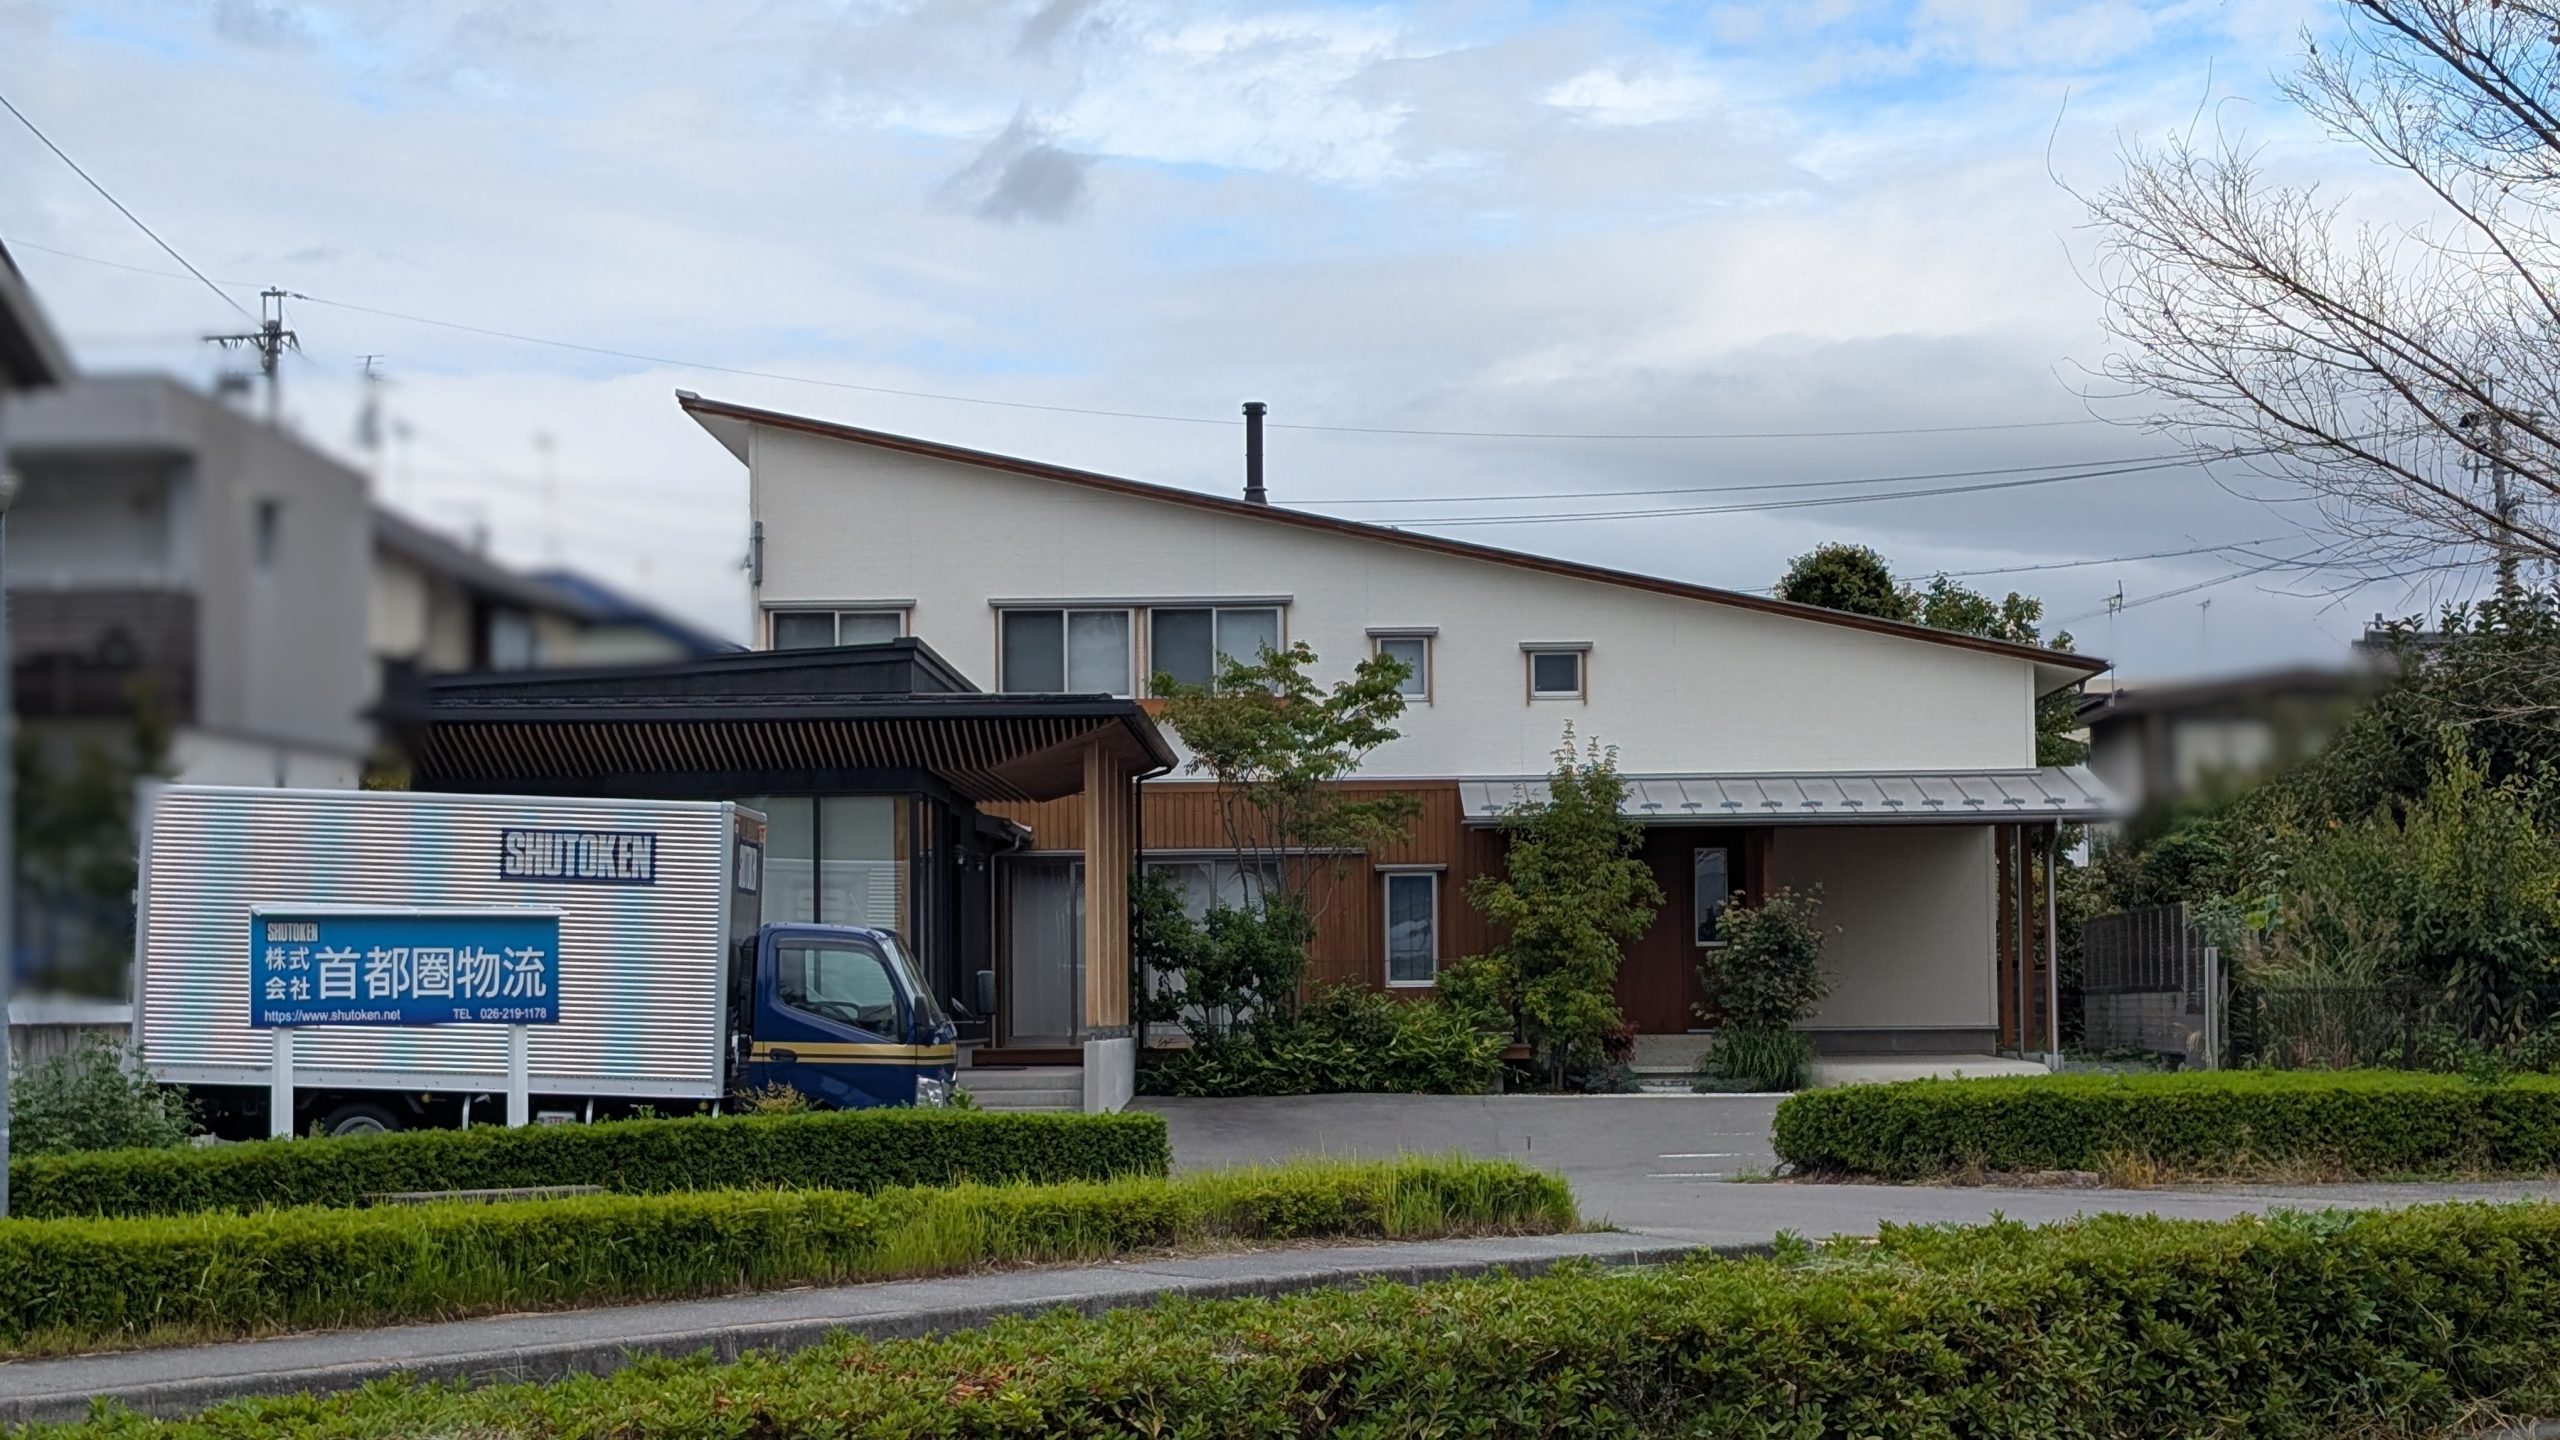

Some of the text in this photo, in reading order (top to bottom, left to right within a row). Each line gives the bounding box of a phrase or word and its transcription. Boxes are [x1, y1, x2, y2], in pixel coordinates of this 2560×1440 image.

[505, 831, 652, 879] SHUTOKEN
[267, 922, 319, 942] SHUTOKEN
[265, 946, 310, 971] 株式
[315, 946, 547, 1000] 首都圏物流
[265, 976, 311, 1001] 会社
[264, 1008, 401, 1024] https://www.shutoken.net
[453, 1007, 547, 1020] TEL 026-219-1178
